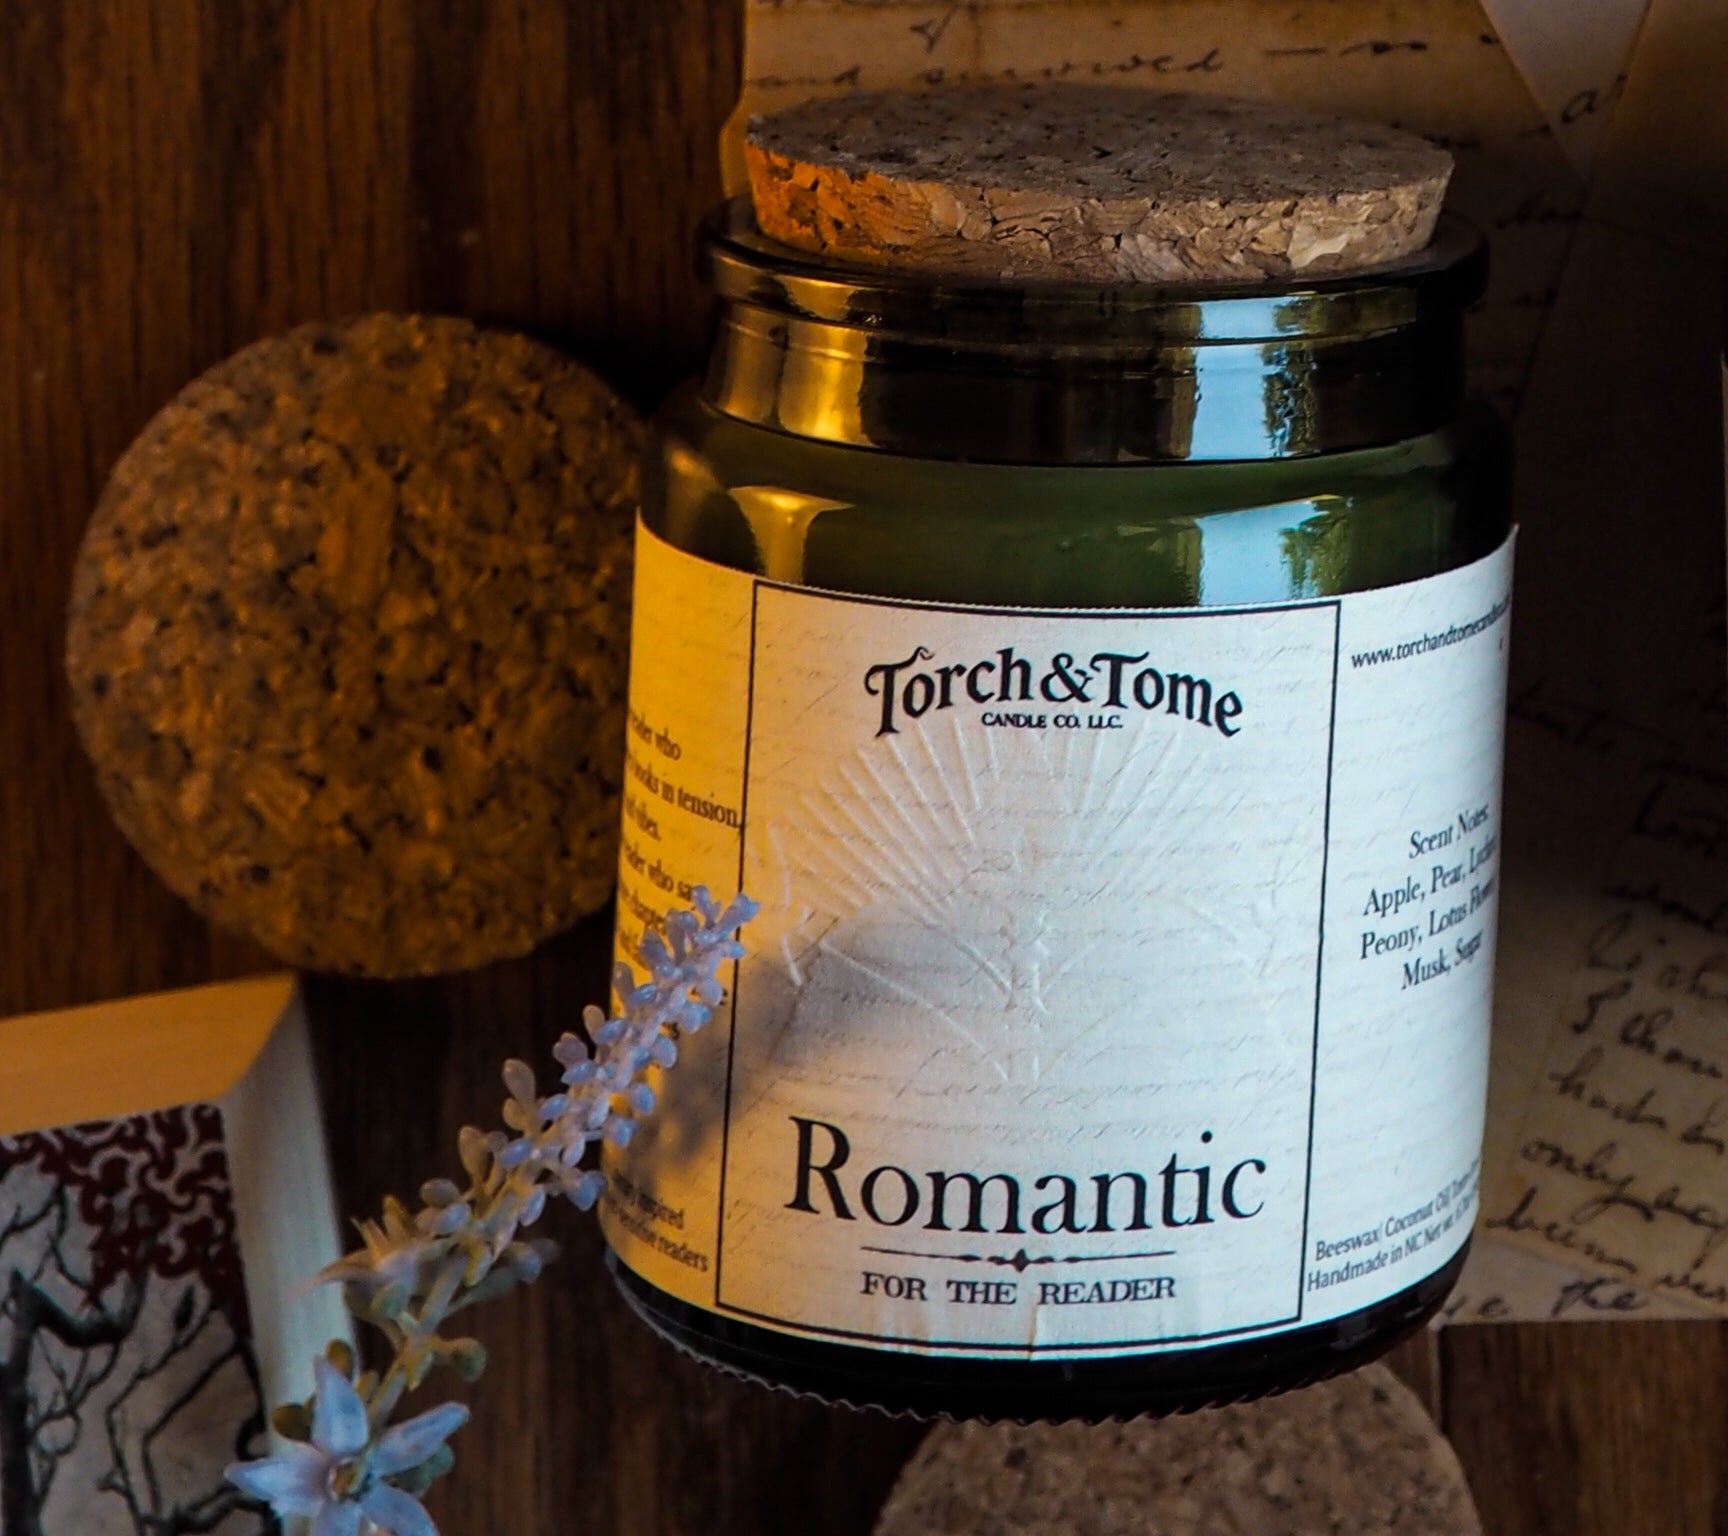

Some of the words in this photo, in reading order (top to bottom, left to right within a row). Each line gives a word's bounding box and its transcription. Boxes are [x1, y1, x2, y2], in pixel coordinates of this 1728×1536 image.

[864, 646, 1243, 738] Torch&Tome
[982, 712, 1046, 728] CANDLE
[1054, 712, 1080, 728] CO.
[1087, 713, 1123, 728] LLC.
[1409, 824, 1454, 859] Scent
[1363, 876, 1425, 919] Apple,
[1360, 925, 1423, 960] Peony,
[1428, 902, 1468, 937] Lotus
[1401, 947, 1451, 990] Musk,
[783, 1115, 1266, 1234] Romantic
[860, 1270, 928, 1301] FOR
[946, 1280, 1017, 1305] THE
[1037, 1276, 1176, 1306] READER
[1307, 1250, 1389, 1292] Handmade
